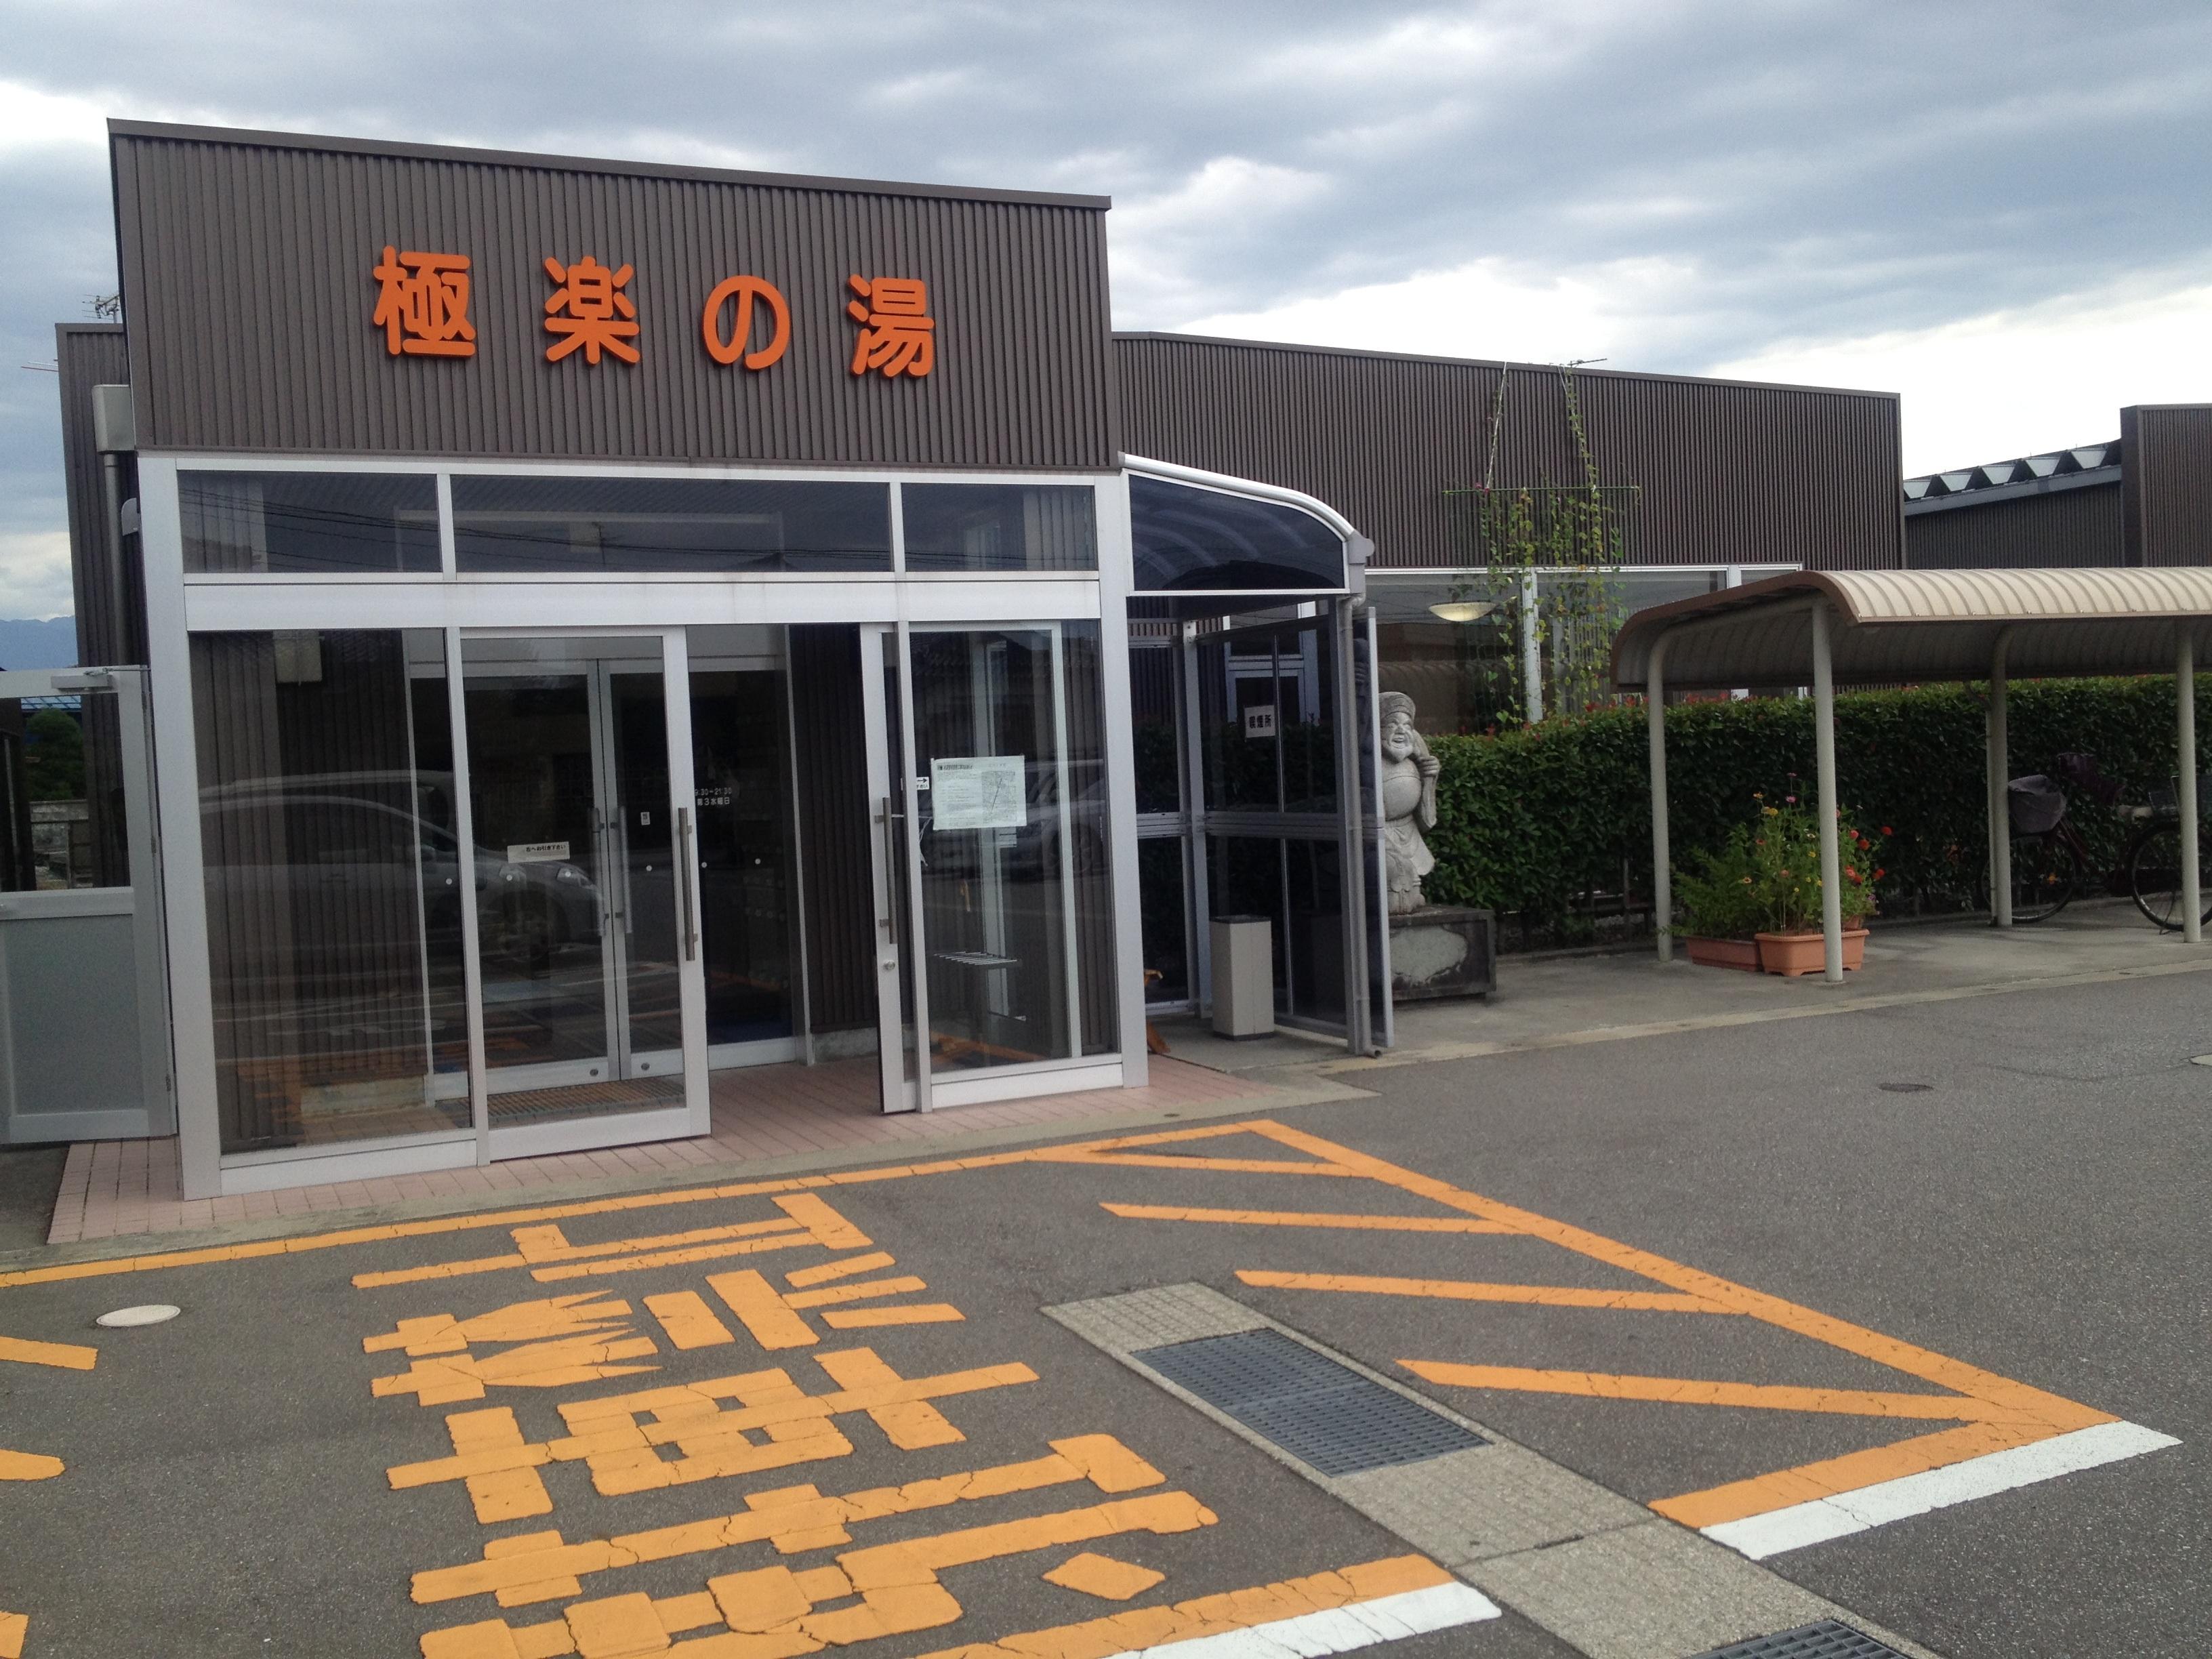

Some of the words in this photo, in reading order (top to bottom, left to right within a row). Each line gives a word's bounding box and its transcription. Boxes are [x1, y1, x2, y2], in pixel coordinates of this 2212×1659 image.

[373, 245, 935, 378] 極楽の湯
[1249, 714, 1271, 729] 喫煙所
